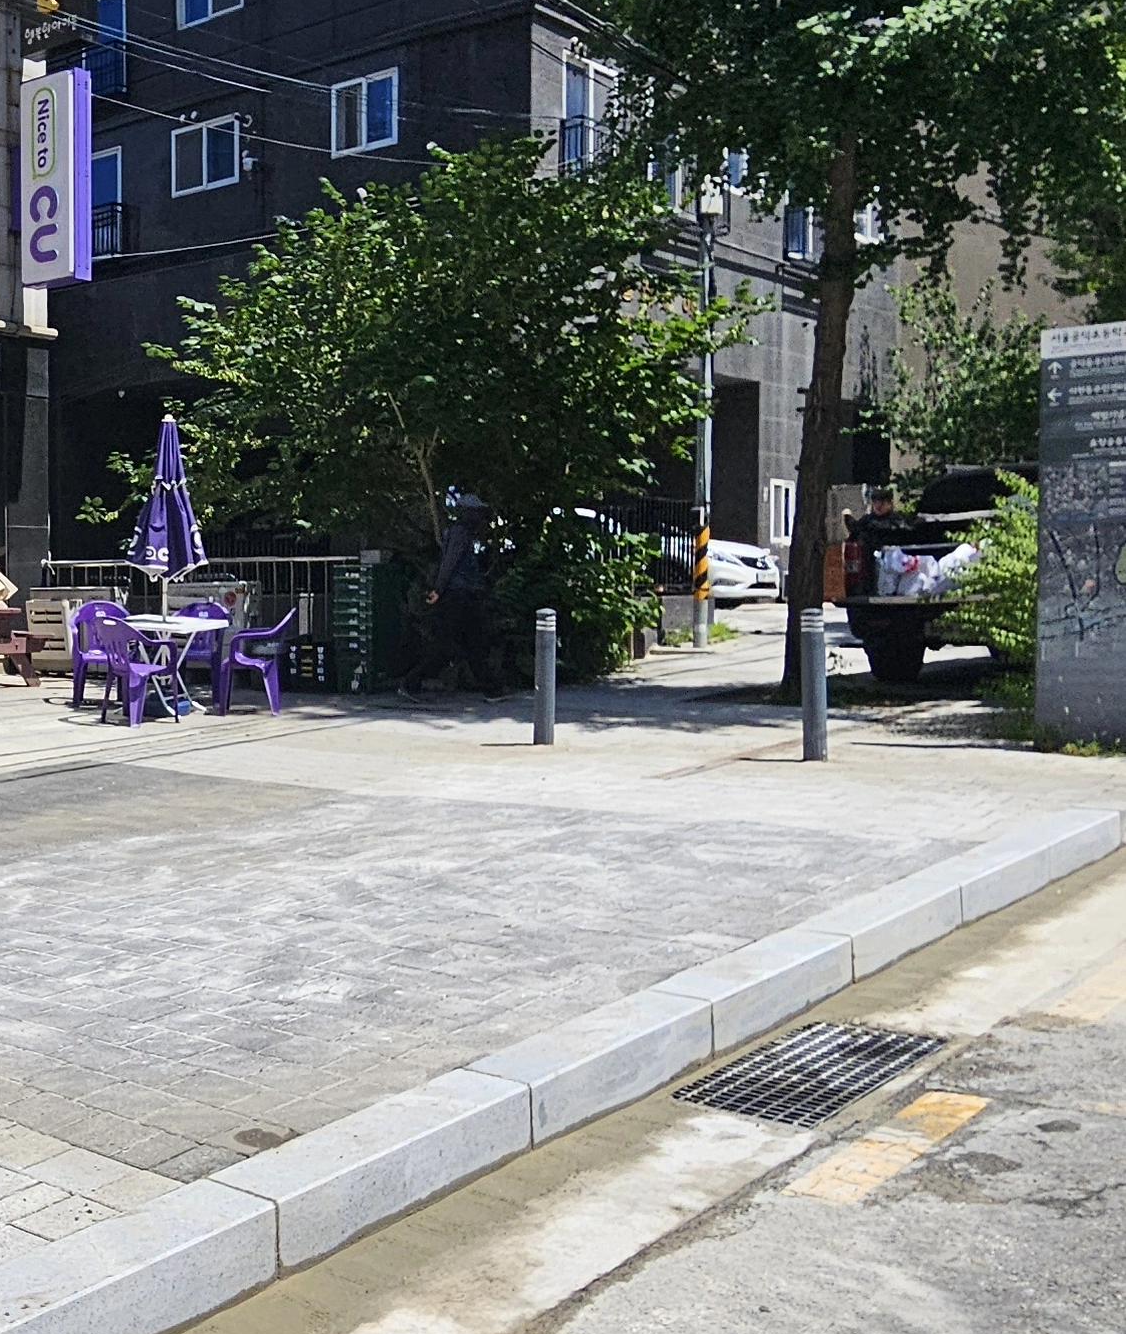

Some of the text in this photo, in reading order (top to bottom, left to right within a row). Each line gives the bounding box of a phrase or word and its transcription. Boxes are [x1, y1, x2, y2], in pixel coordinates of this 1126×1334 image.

[29, 98, 59, 264] Nice to CU
